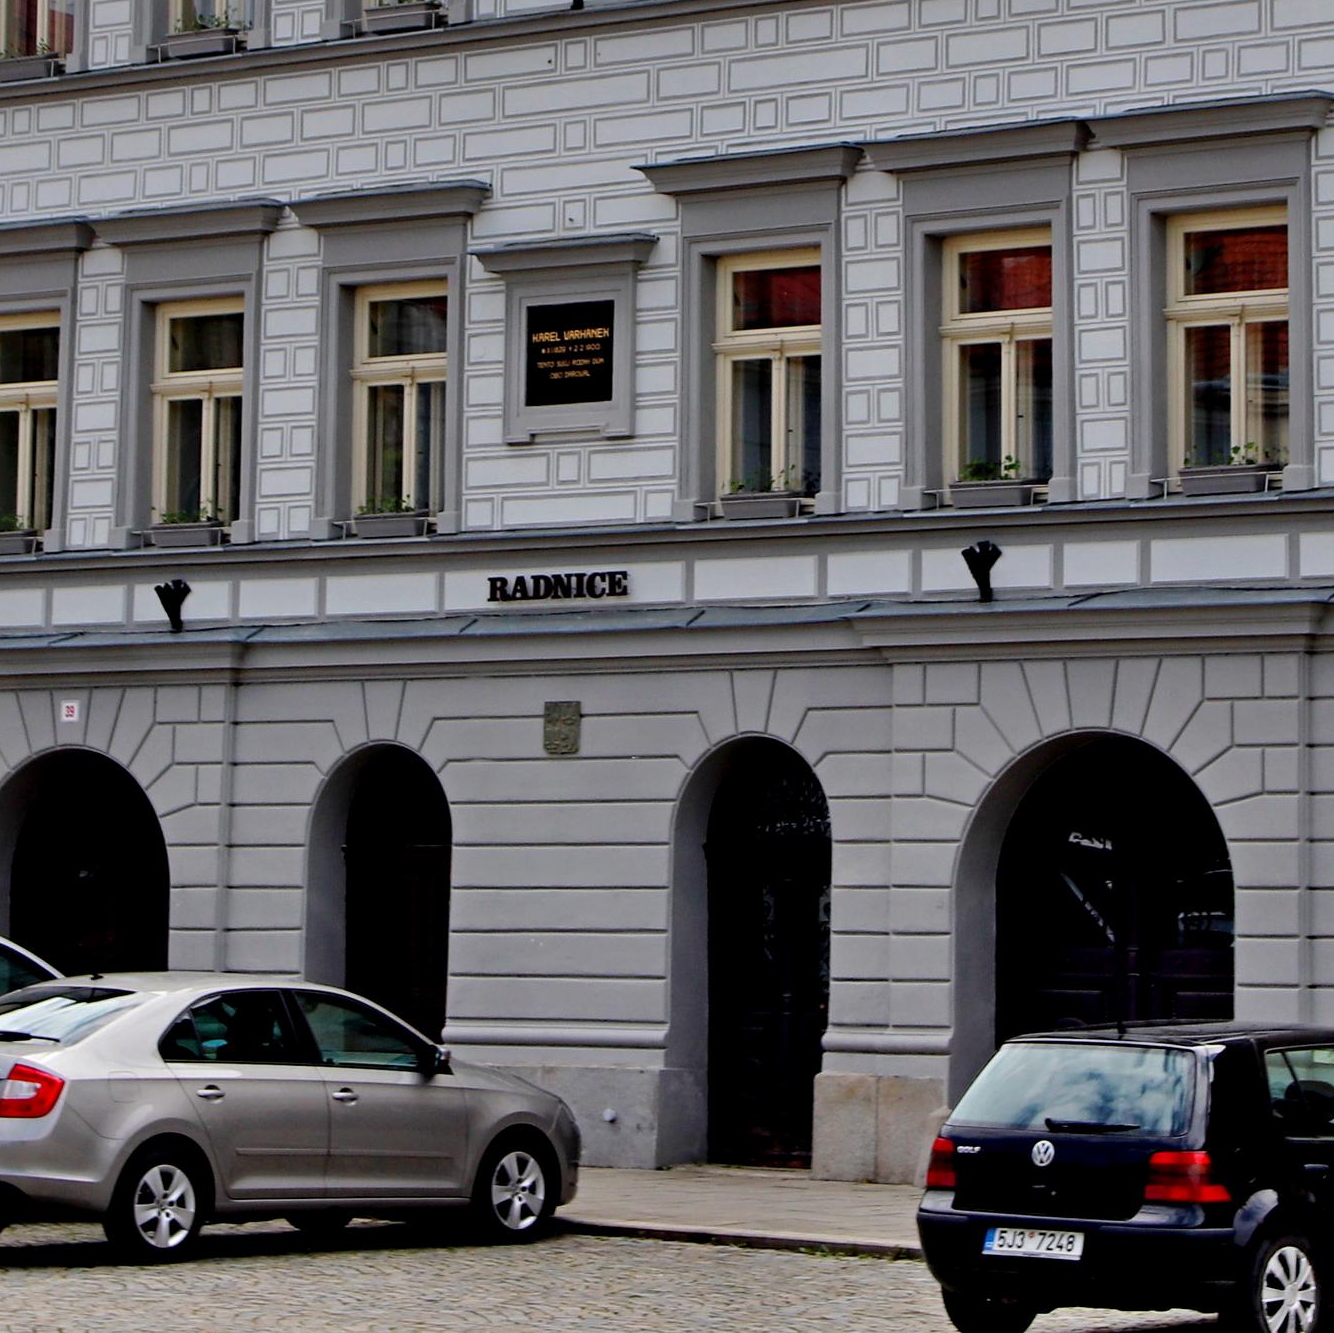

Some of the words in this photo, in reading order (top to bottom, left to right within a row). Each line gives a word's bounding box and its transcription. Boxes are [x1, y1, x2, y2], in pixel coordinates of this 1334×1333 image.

[532, 332, 561, 343] KAREL
[487, 570, 628, 602] RADNICE
[997, 1230, 1026, 1250] 5J3
[1036, 1232, 1076, 1253] 7248
